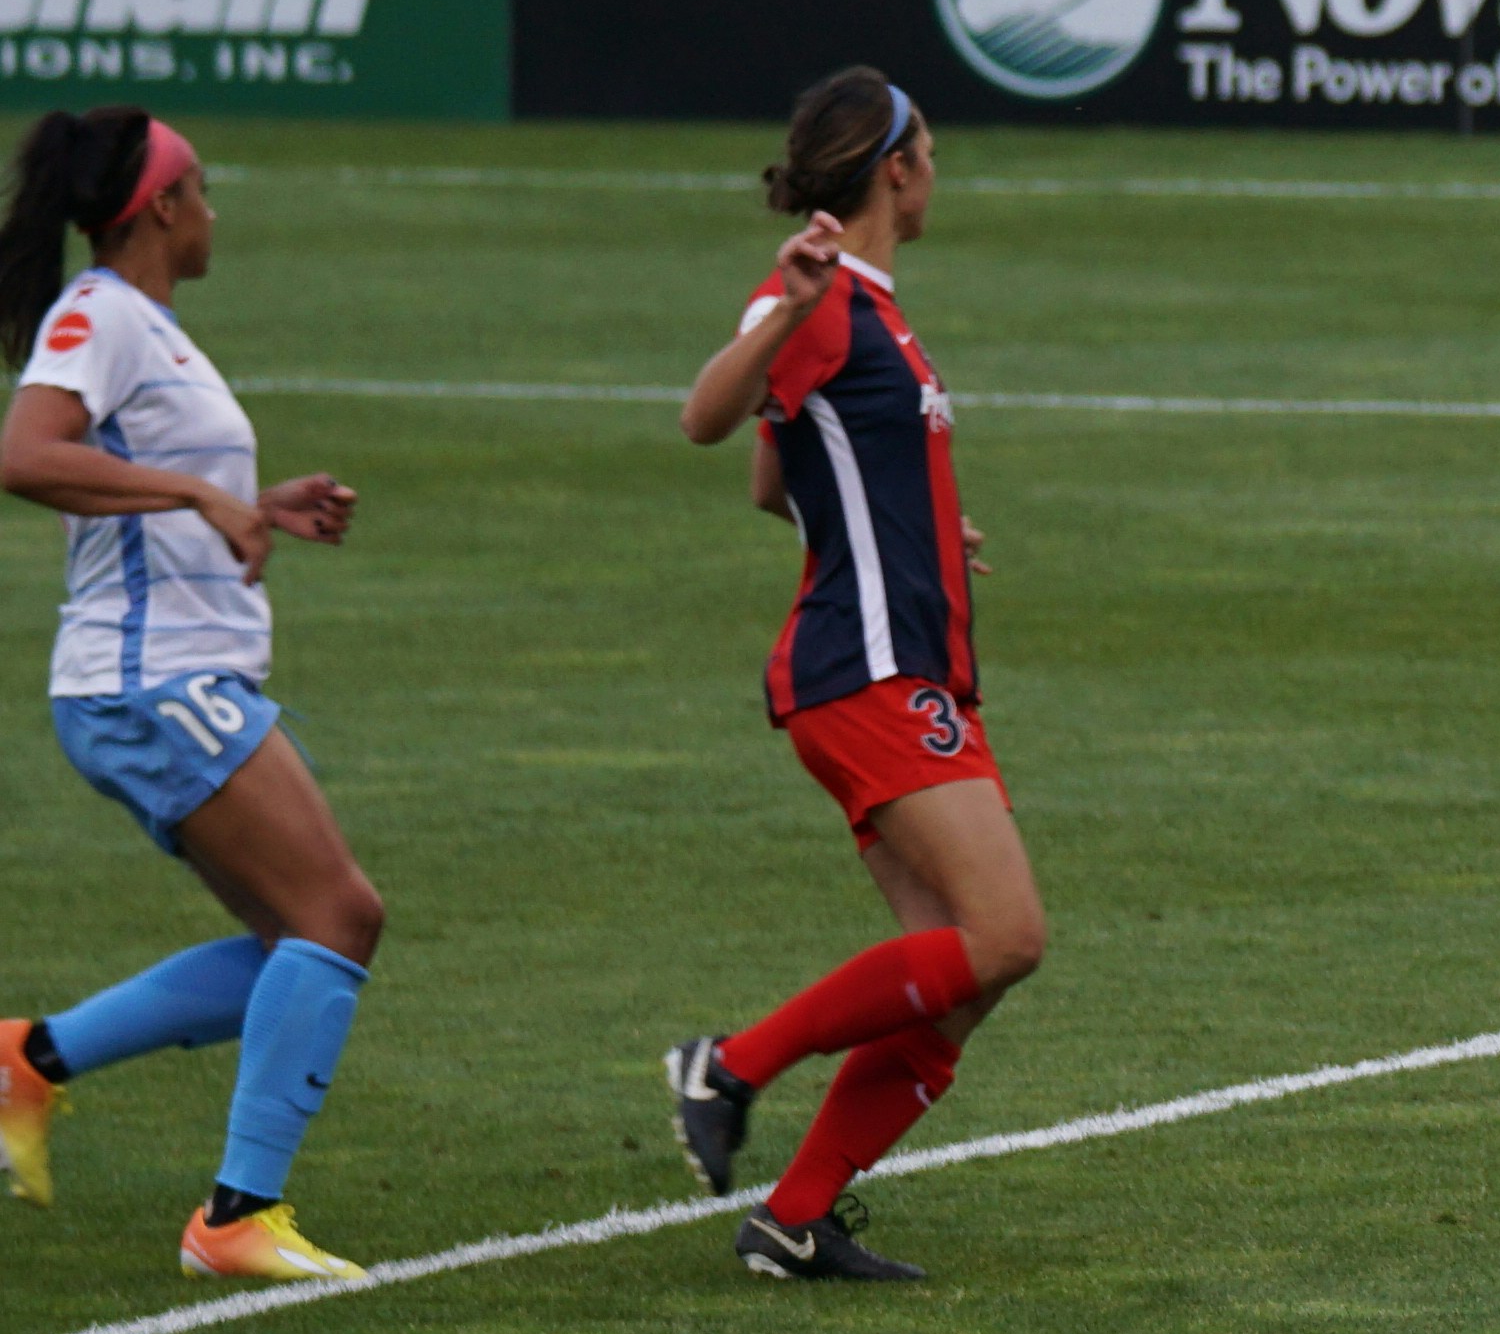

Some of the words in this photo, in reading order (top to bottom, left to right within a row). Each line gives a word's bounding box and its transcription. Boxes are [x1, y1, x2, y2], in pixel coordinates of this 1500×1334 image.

[214, 41, 355, 85] INC.
[1178, 42, 1283, 103] The
[1293, 44, 1453, 105] Power
[157, 674, 245, 758] 16
[908, 687, 967, 757] 3
